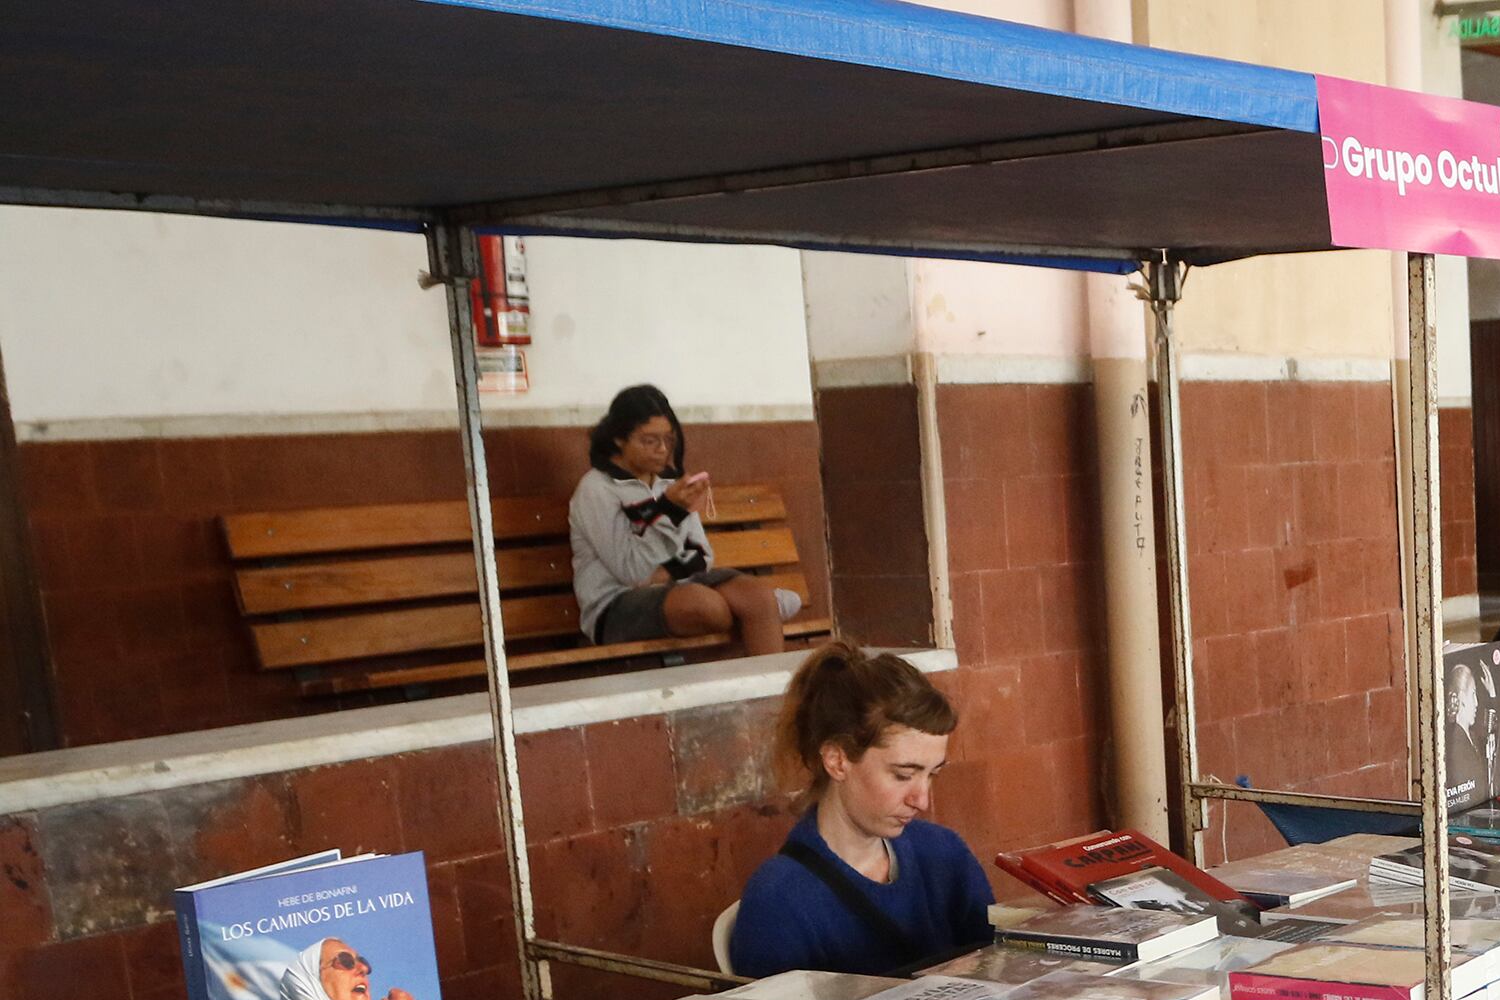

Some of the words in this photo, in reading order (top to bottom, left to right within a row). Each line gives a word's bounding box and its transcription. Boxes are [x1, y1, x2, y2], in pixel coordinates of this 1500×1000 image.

[1342, 136, 1433, 196] Grupo
[1457, 779, 1476, 794] PERÓN
[278, 896, 301, 908] HEBE
[302, 894, 315, 904] DE
[315, 885, 358, 901] BONAFINI
[221, 921, 254, 942] LOS
[257, 906, 331, 934] CAMINOS
[334, 901, 355, 920] DE
[357, 898, 376, 915] LA
[378, 891, 415, 909] VIDA
[1082, 945, 1092, 954] DE
[1093, 946, 1122, 956] MADRES
